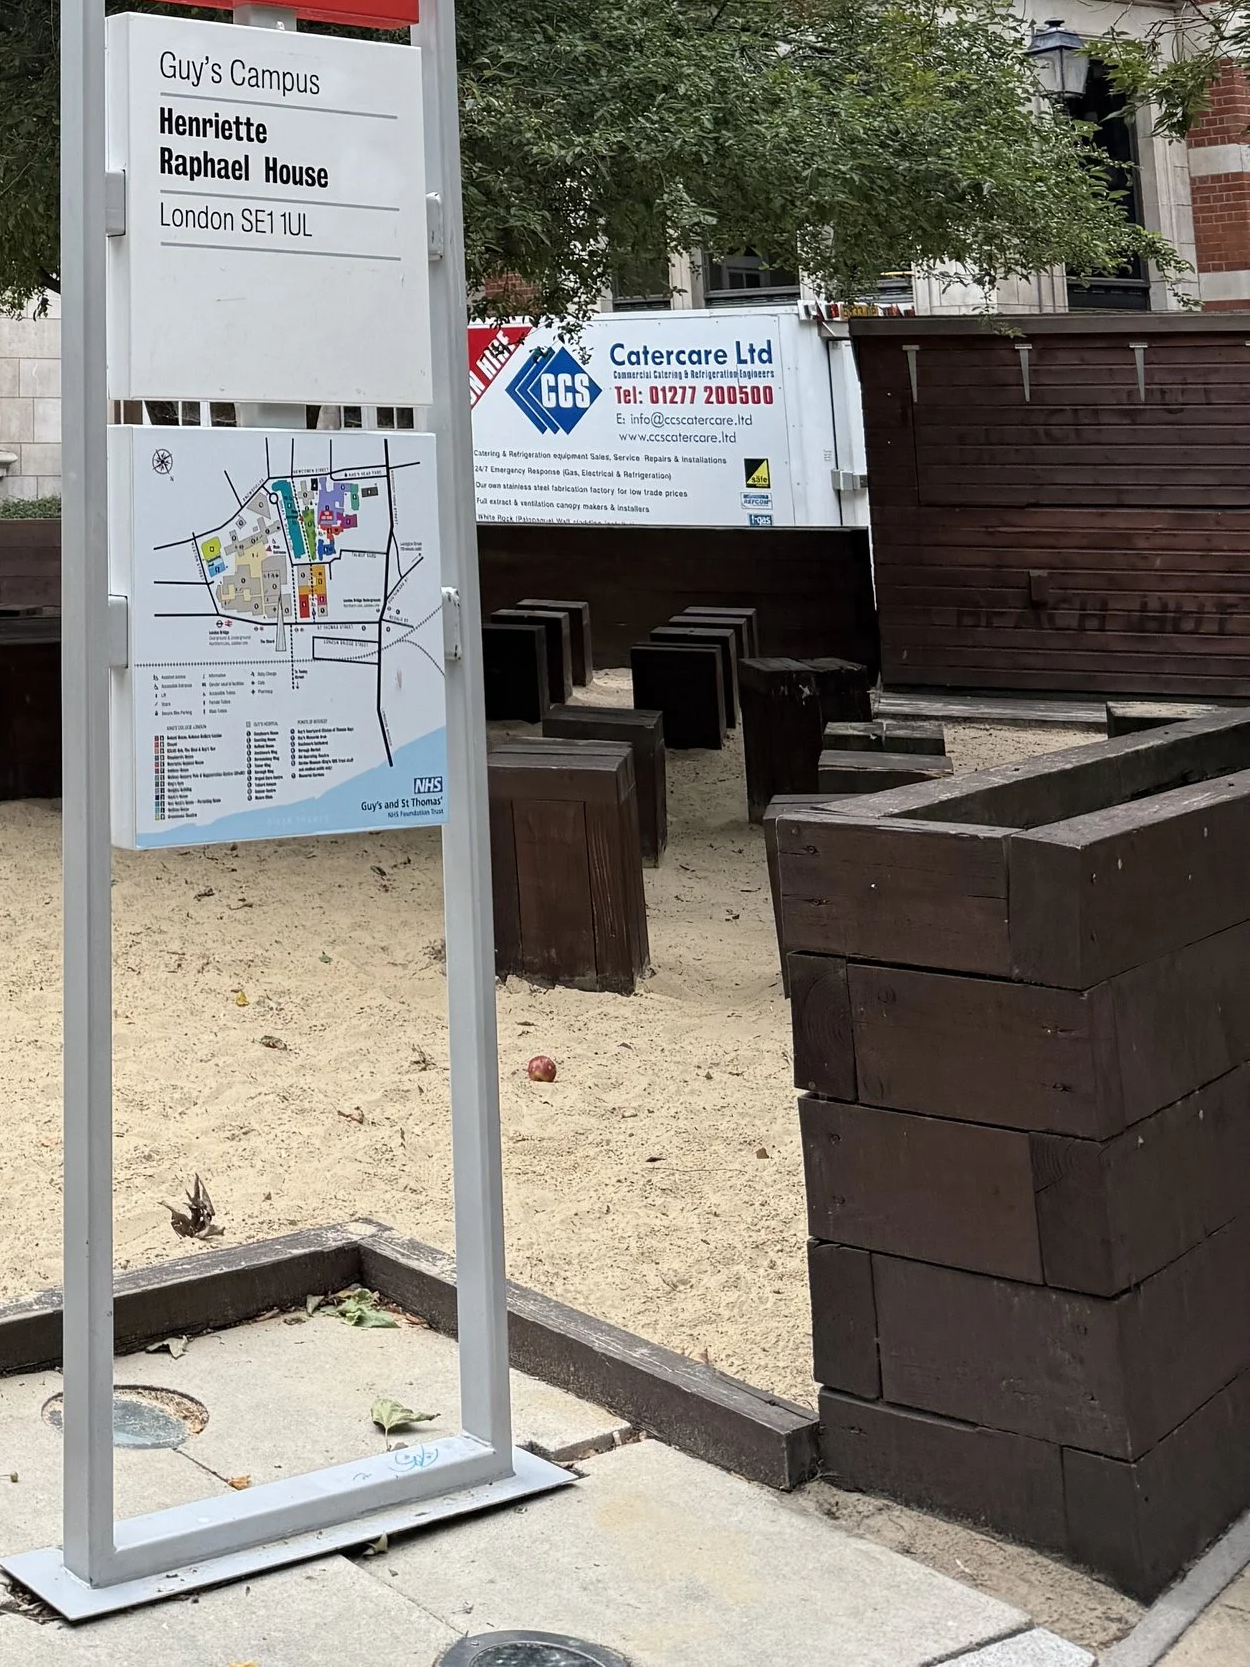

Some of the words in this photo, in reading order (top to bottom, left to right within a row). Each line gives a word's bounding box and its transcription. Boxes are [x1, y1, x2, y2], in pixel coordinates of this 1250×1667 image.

[160, 51, 222, 86] Guy's
[230, 59, 320, 96] Campus
[160, 107, 268, 143] Henriette
[160, 147, 250, 182] Raphael
[265, 156, 328, 188] House
[160, 202, 234, 231] London
[242, 208, 274, 234] SE1
[280, 211, 312, 237] 1UL
[610, 342, 728, 366] Catercare
[736, 340, 772, 364] Ltd
[614, 370, 651, 380] Commercial
[654, 370, 682, 380] Catering
[690, 370, 738, 380] Refrigeration
[740, 370, 774, 380] Engineers
[540, 373, 590, 408] CCS
[614, 386, 643, 404] Tel:
[650, 386, 696, 404] 01277
[704, 386, 774, 404] 200500
[616, 413, 626, 424] E:
[630, 412, 752, 428] info@ccscatercare.ltd
[618, 432, 736, 444] www.ccscatercare.ltd
[474, 450, 500, 458] Catering
[508, 450, 551, 459] Refrigeration
[644, 455, 672, 463] Repairs
[490, 466, 526, 475] Emergency
[528, 468, 560, 476] Response
[590, 486, 614, 495] factory
[520, 500, 554, 508] ventilation
[556, 502, 581, 511] canopy
[583, 503, 608, 511] makers
[414, 778, 442, 793] NHS
[361, 800, 382, 811] Guy's
[384, 798, 399, 809] and
[401, 798, 409, 808] St
[411, 796, 443, 808] Thomas'
